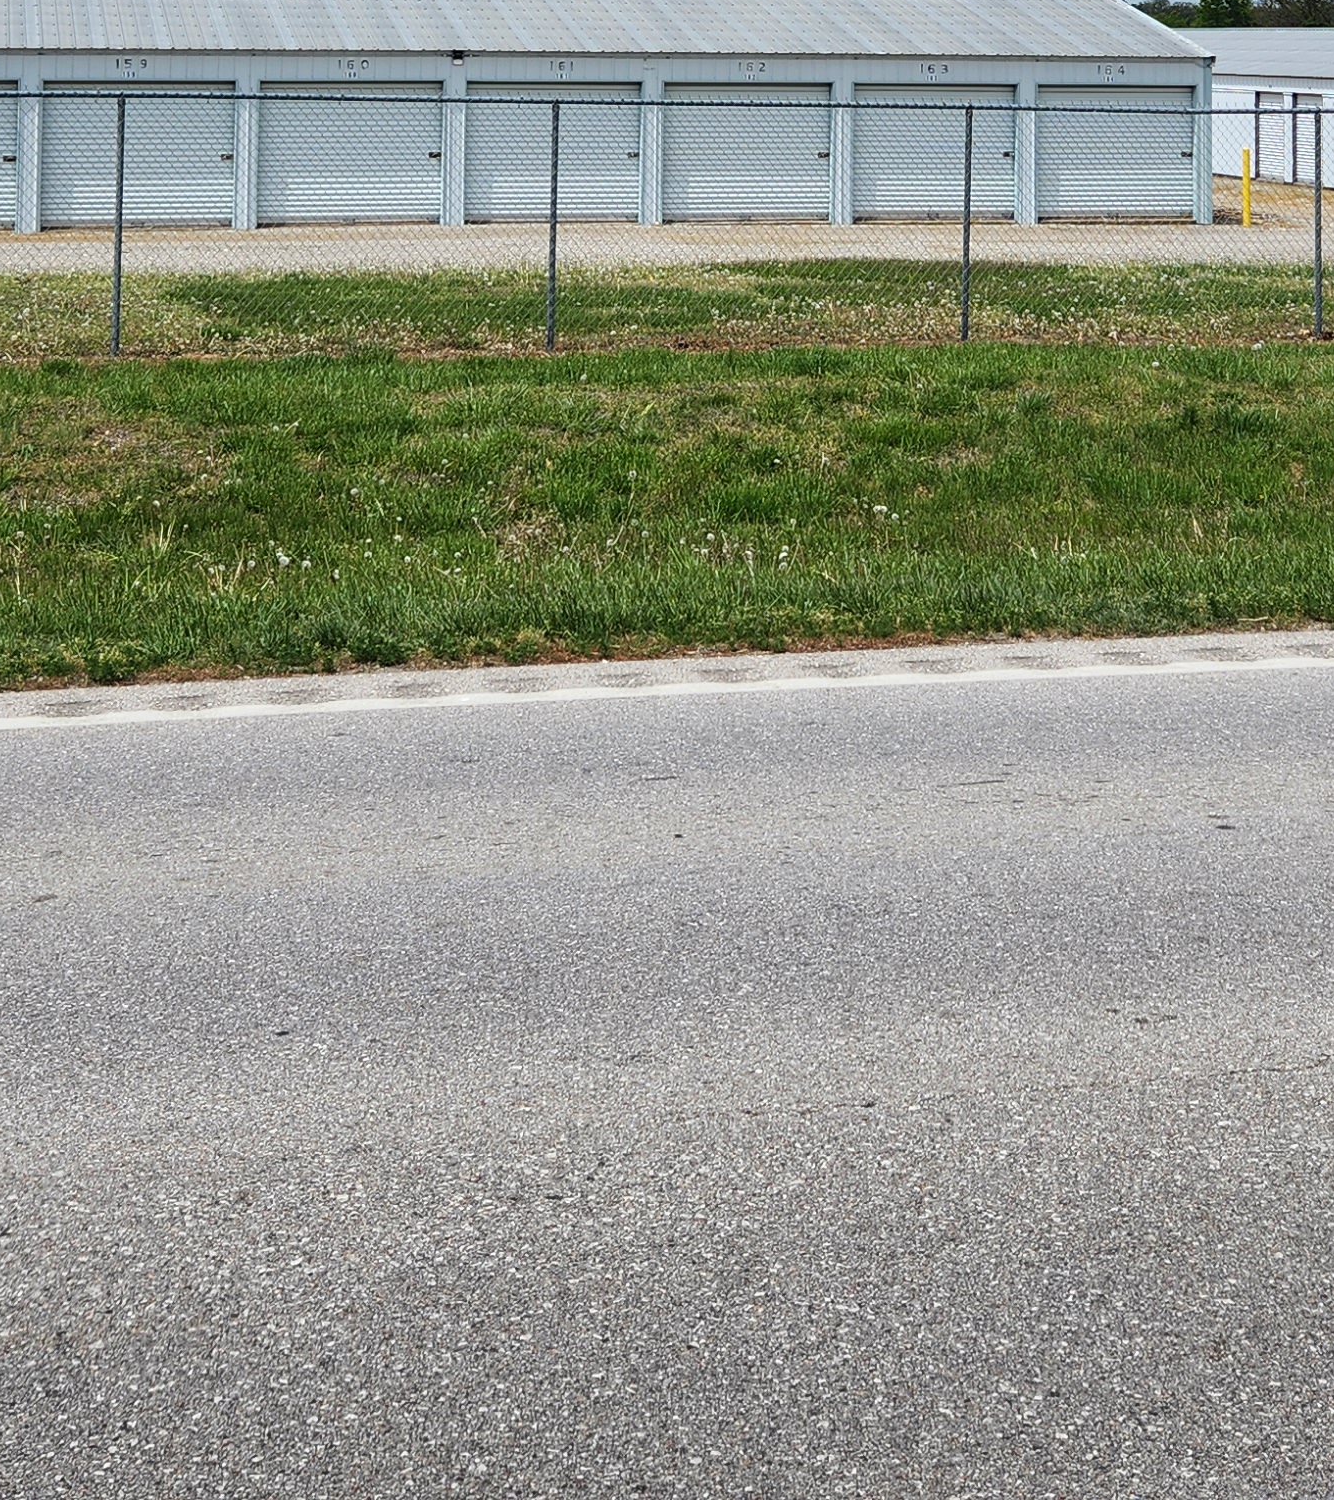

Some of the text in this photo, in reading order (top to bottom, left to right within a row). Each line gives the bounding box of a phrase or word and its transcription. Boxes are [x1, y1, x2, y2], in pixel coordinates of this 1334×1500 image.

[116, 58, 148, 69] 159
[338, 60, 369, 70] 160
[550, 61, 574, 71] 161
[738, 62, 766, 72] 162
[920, 63, 949, 74] 163
[1097, 65, 1126, 75] 164
